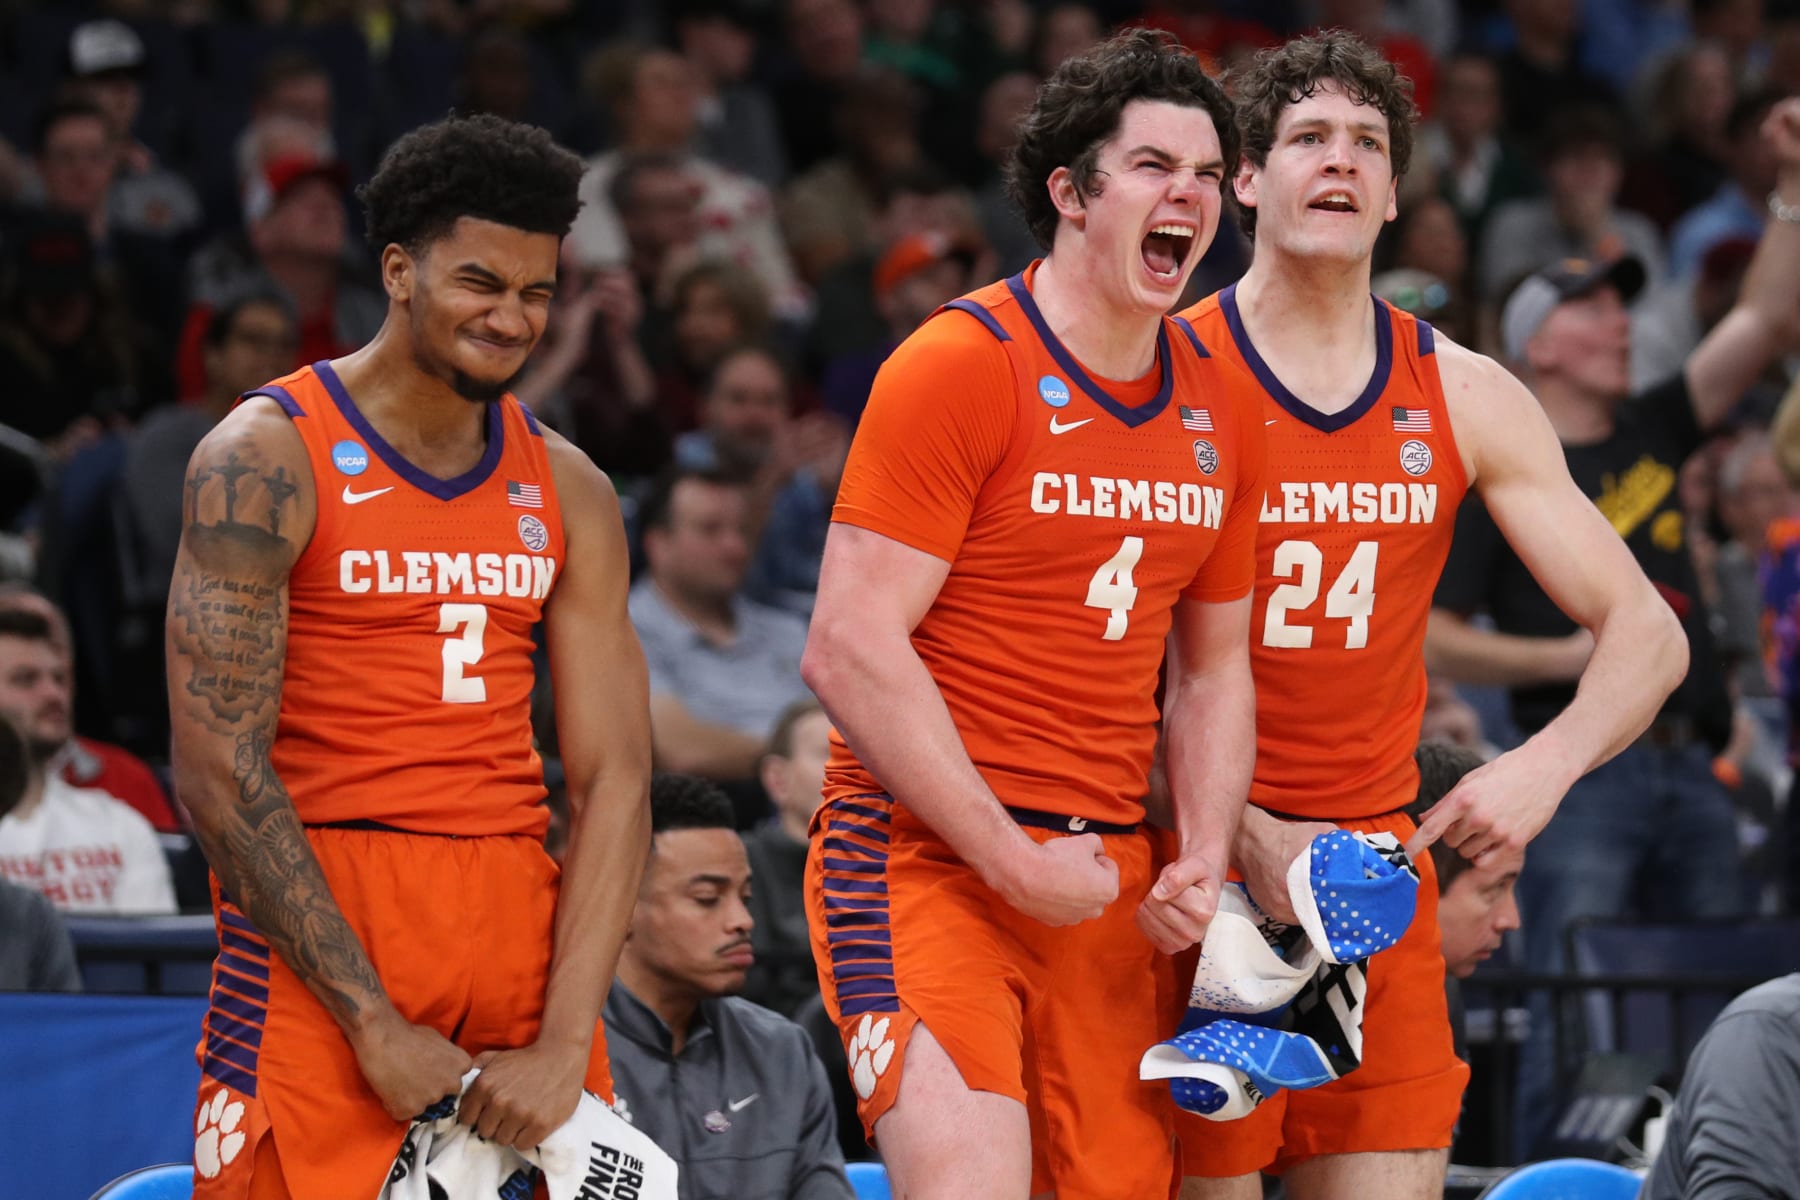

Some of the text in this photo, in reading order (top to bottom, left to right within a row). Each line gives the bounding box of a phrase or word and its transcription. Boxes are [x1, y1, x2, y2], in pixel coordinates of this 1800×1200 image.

[1043, 389, 1068, 400] NCAA
[337, 456, 367, 466] NCAA
[1199, 450, 1215, 462] ACC
[1405, 451, 1428, 461] ACC
[1030, 472, 1224, 530] CLEMSON
[1258, 482, 1438, 524] LEMSON
[522, 526, 543, 536] ACC
[340, 550, 556, 600] CLEMSON
[1084, 535, 1144, 641] 4
[1262, 540, 1379, 649] 24
[435, 602, 488, 703] 2
[623, 1153, 644, 1173] THE
